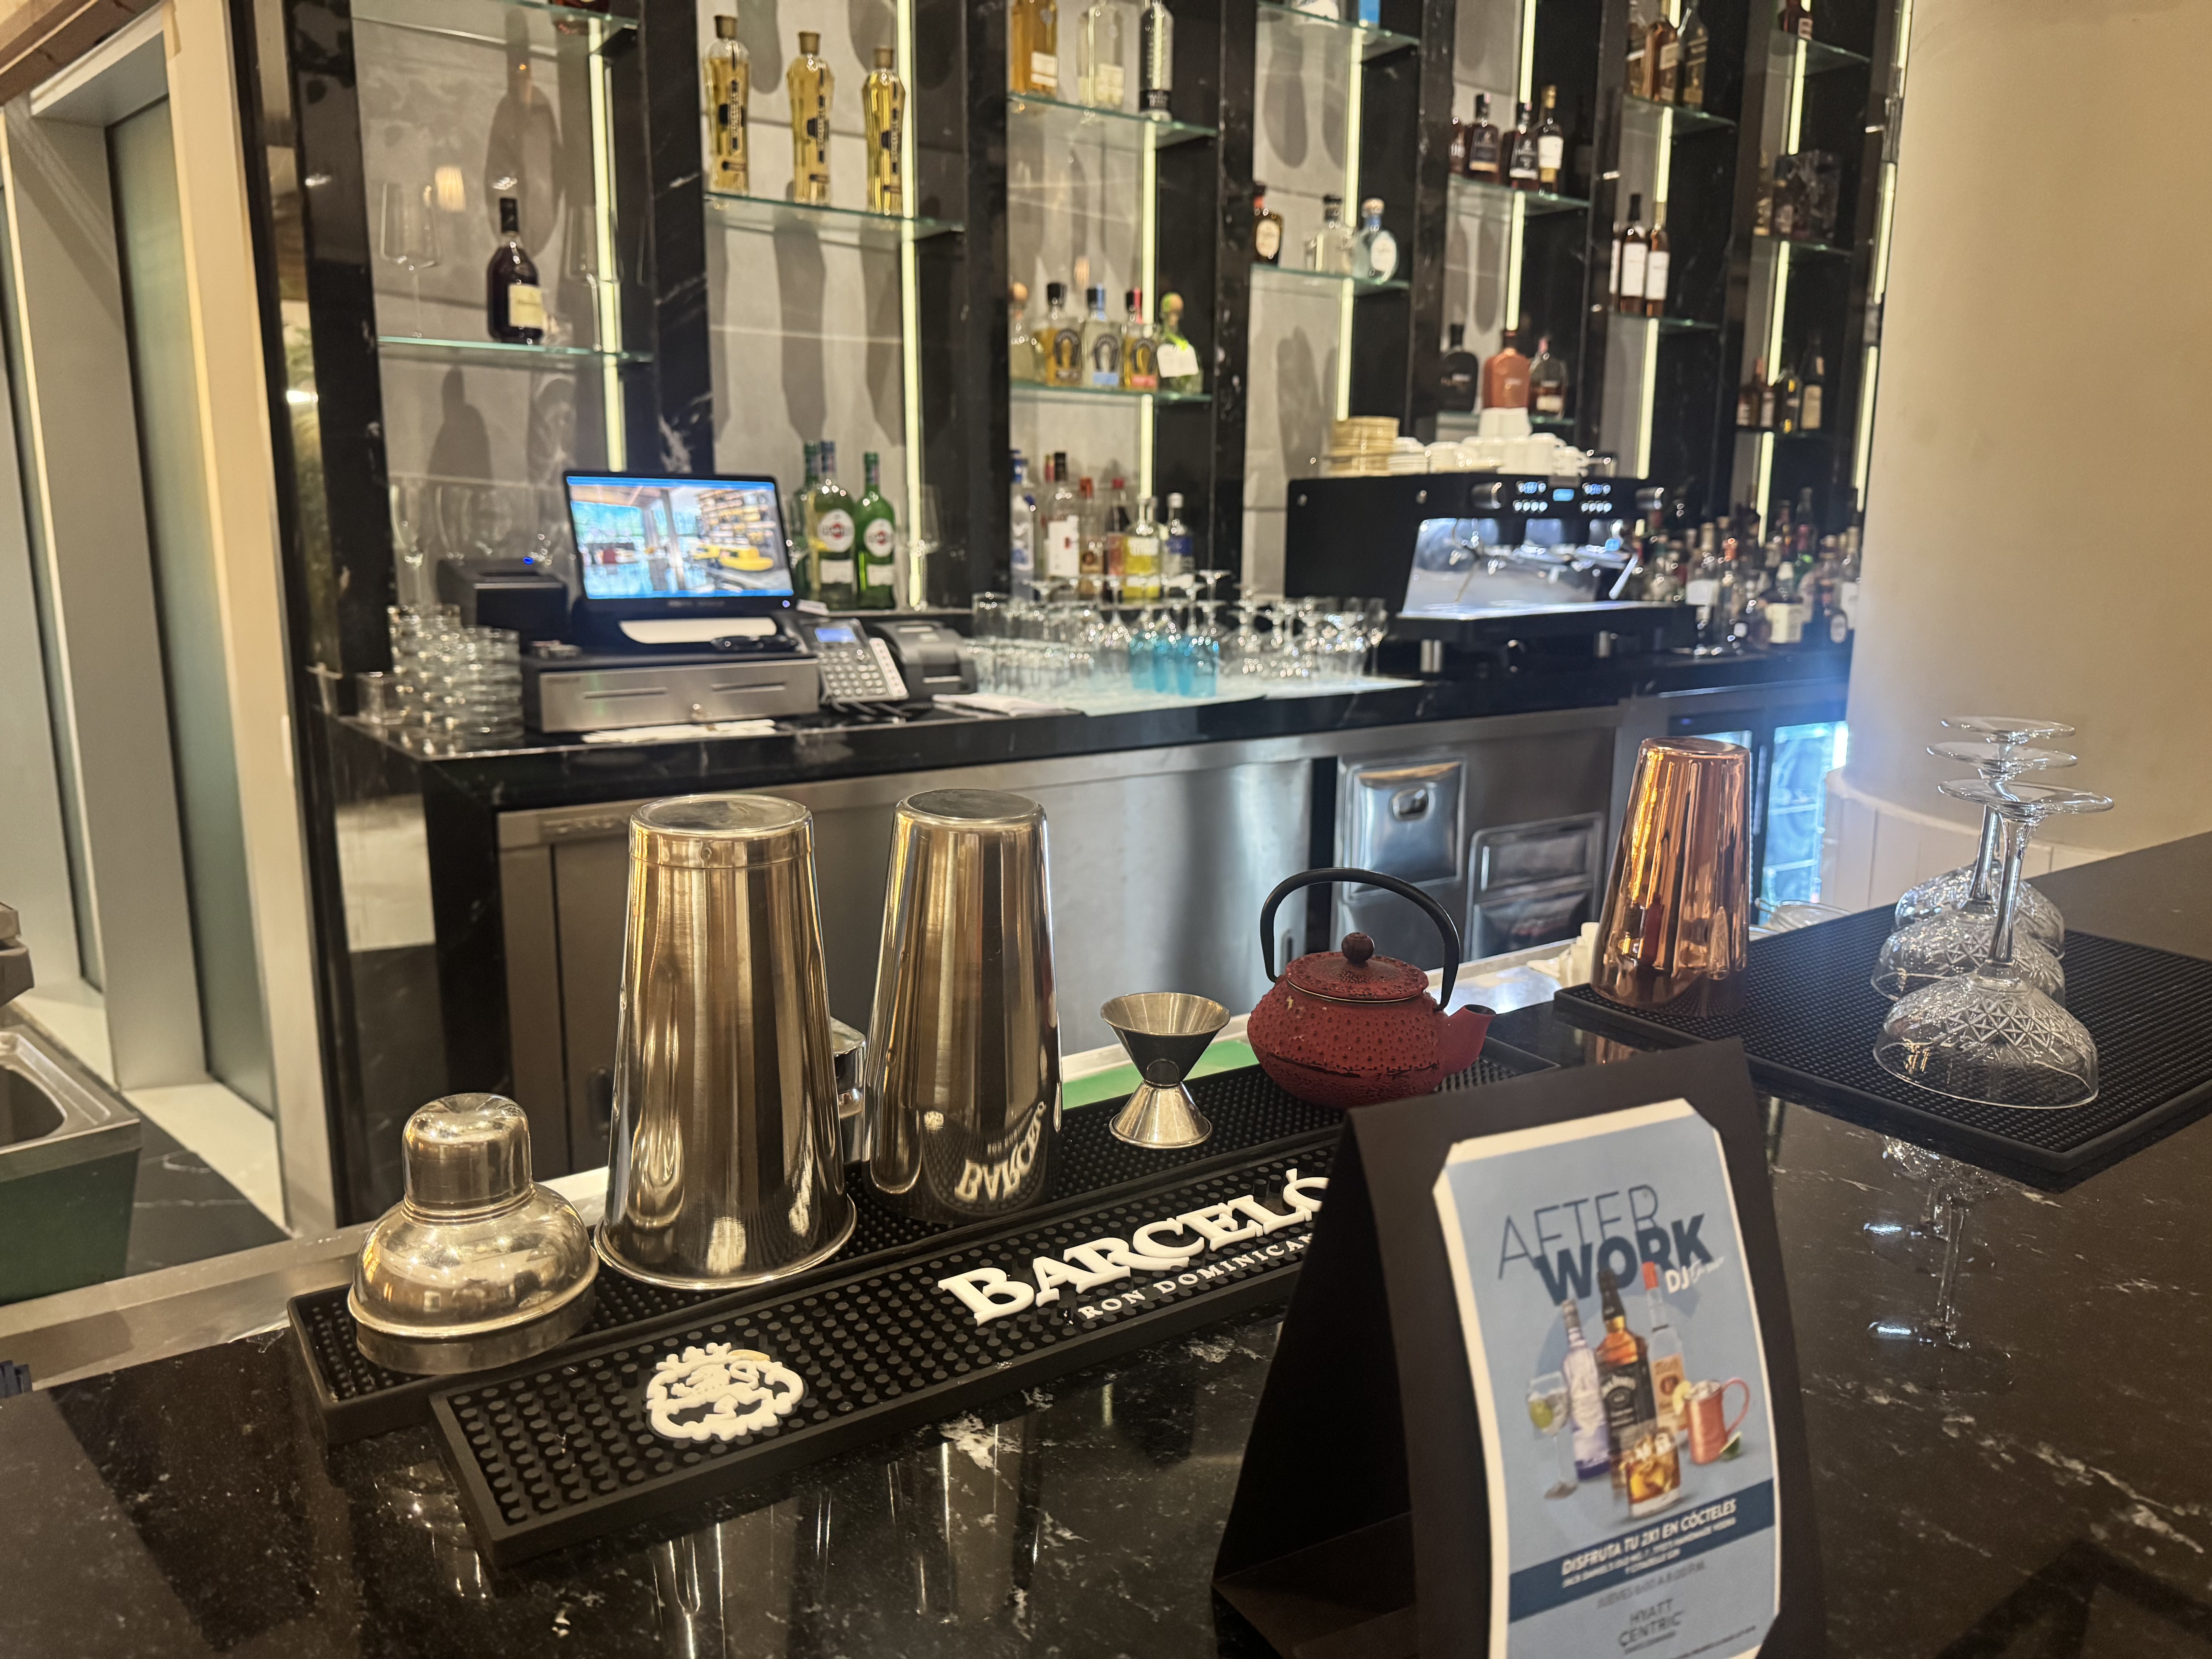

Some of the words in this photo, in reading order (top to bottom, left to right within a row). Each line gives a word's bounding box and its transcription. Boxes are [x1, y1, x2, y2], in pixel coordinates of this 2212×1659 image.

[1498, 1184, 1661, 1280] AFTER
[1534, 1213, 1713, 1306] WORK
[1078, 1290, 1146, 1319] RON
[1562, 1542, 1621, 1576] DISFRUTA
[1624, 1535, 1639, 1552] TU
[1662, 1520, 1679, 1539] EN
[1680, 1498, 1737, 1531] CÓCTELES
